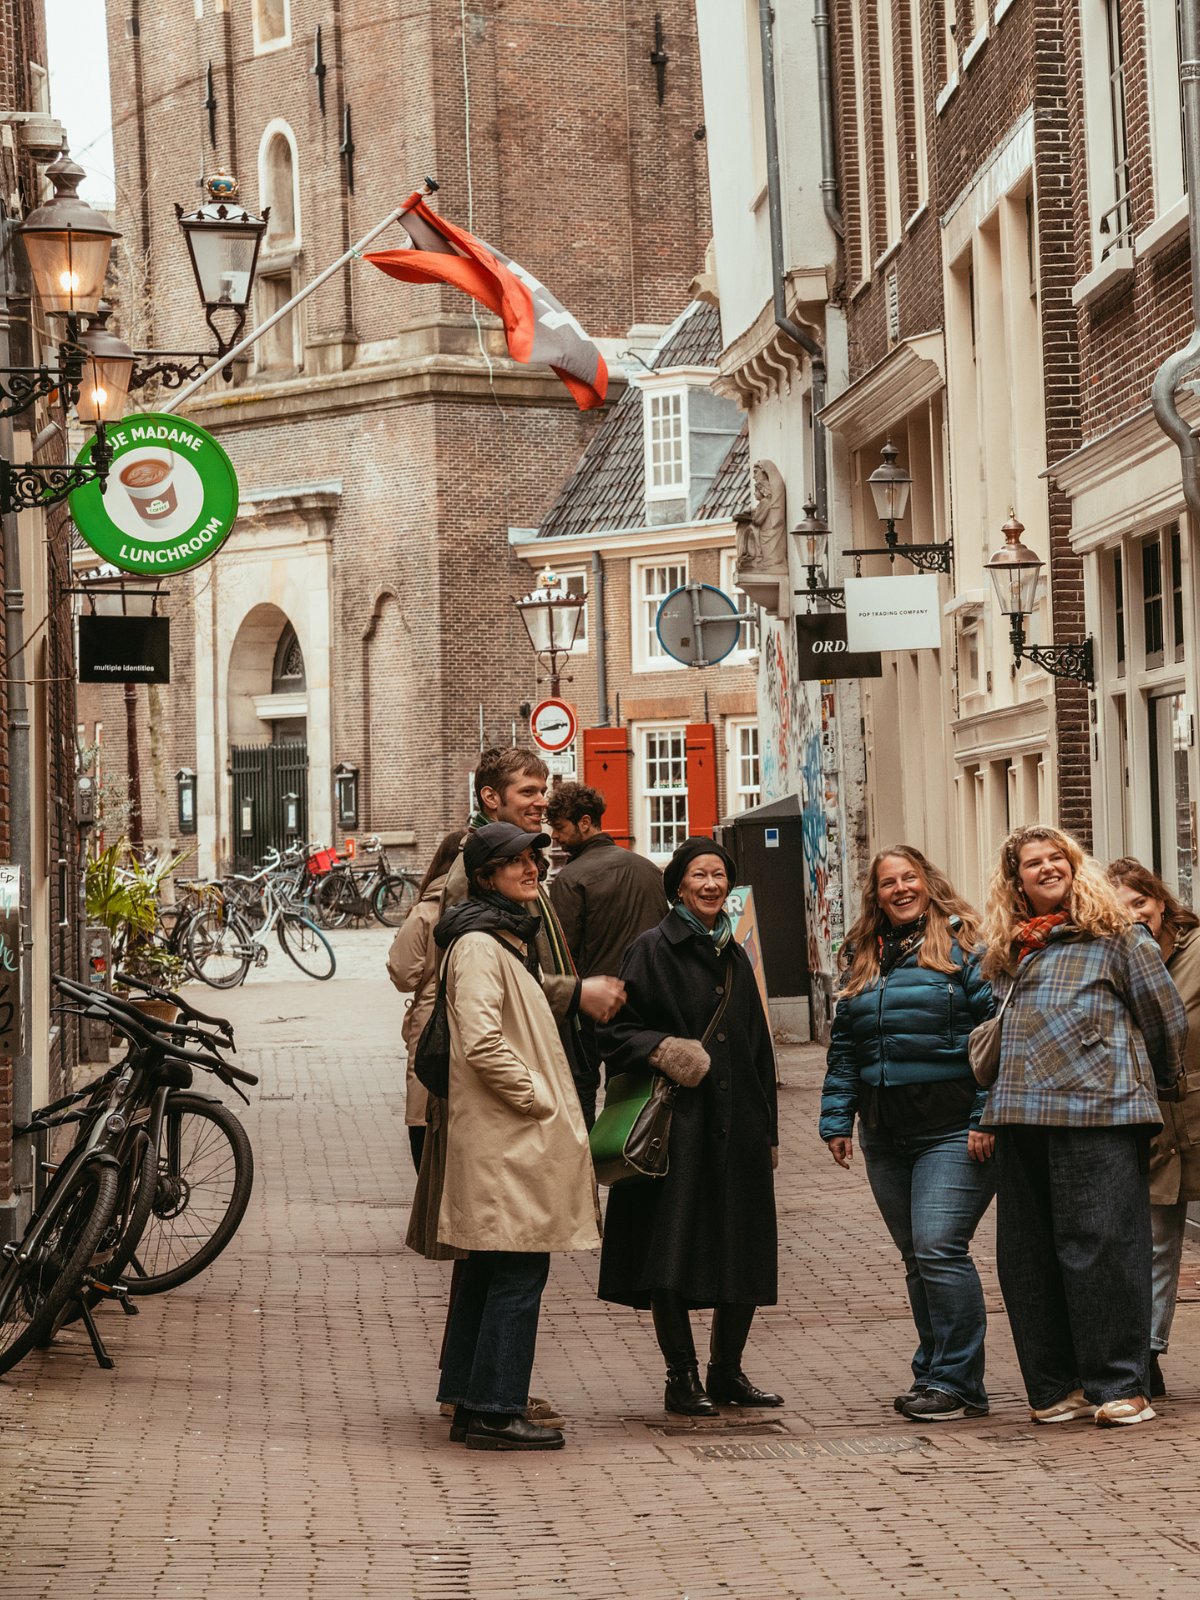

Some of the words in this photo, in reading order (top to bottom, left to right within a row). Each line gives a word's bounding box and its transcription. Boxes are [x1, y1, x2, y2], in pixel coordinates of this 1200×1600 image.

[131, 426, 204, 452] MADAME
[118, 516, 223, 564] LUNCHROOM
[811, 640, 849, 654] ORD
[93, 664, 122, 673] multiple
[123, 664, 155, 672] identities
